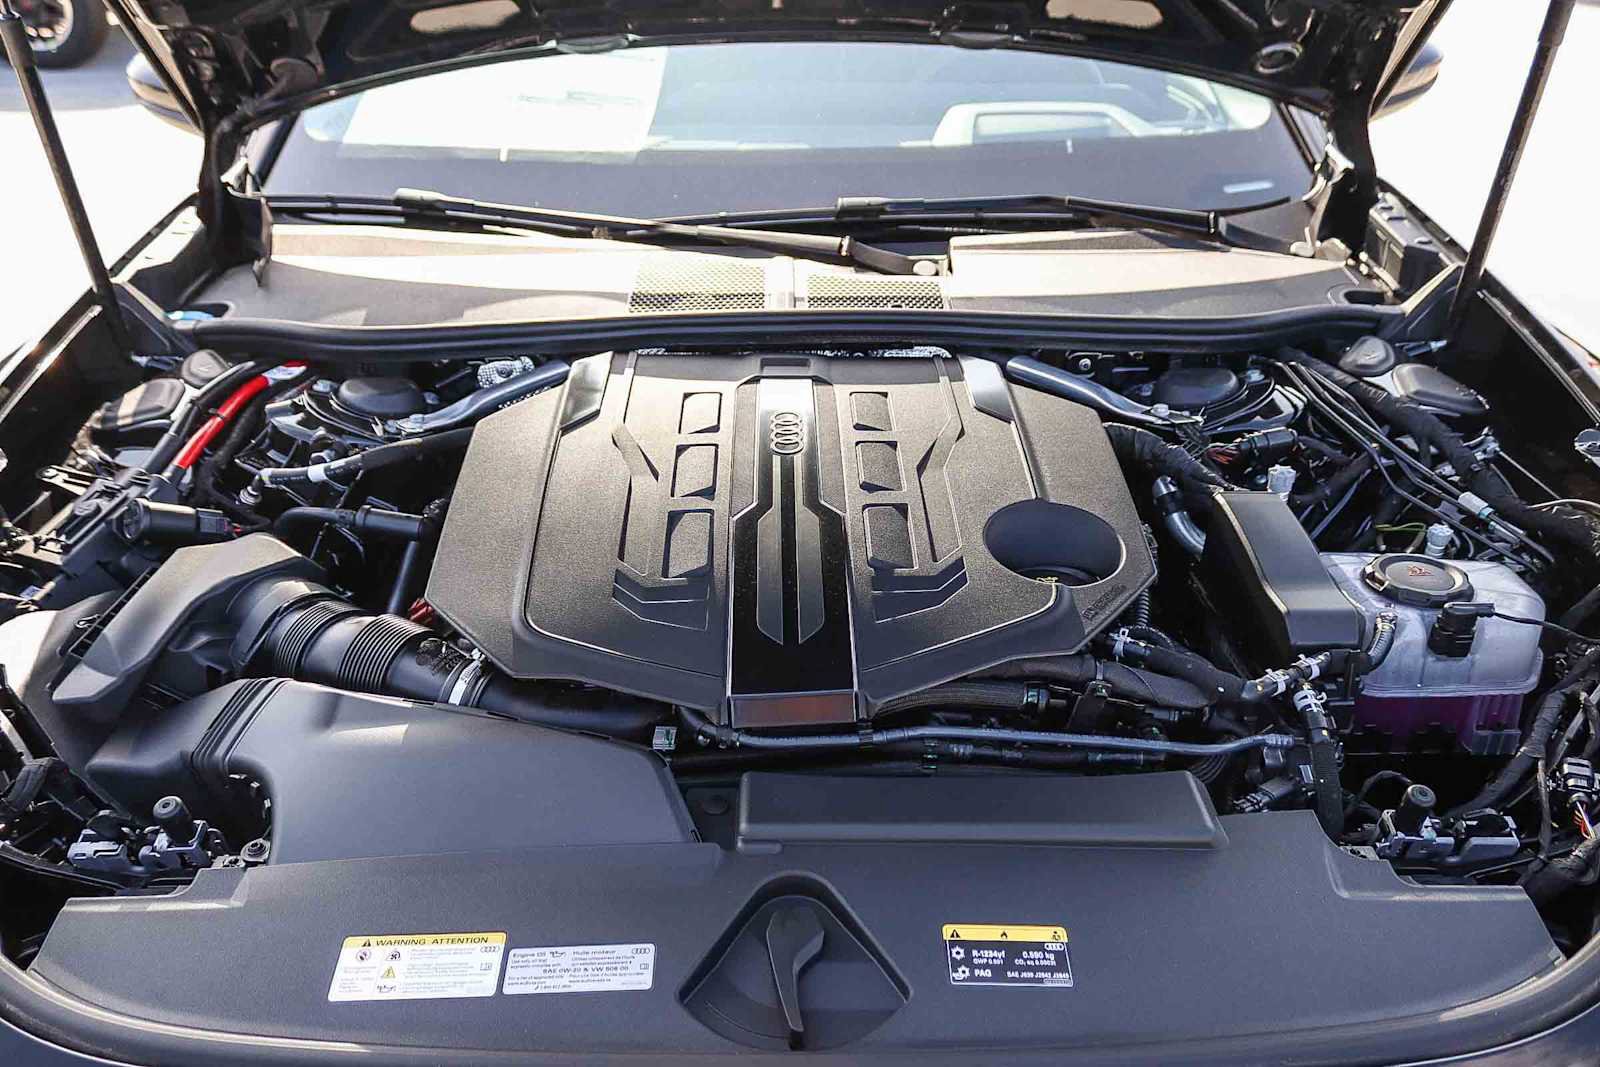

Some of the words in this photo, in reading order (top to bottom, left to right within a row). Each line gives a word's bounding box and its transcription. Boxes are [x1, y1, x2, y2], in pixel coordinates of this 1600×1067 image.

[376, 938, 426, 946] WARNING
[431, 936, 488, 945] ATTENTION
[972, 949, 1005, 959] R-1234yf
[1044, 951, 1055, 961] kg
[973, 957, 988, 965] GWP
[974, 967, 992, 977] PAG
